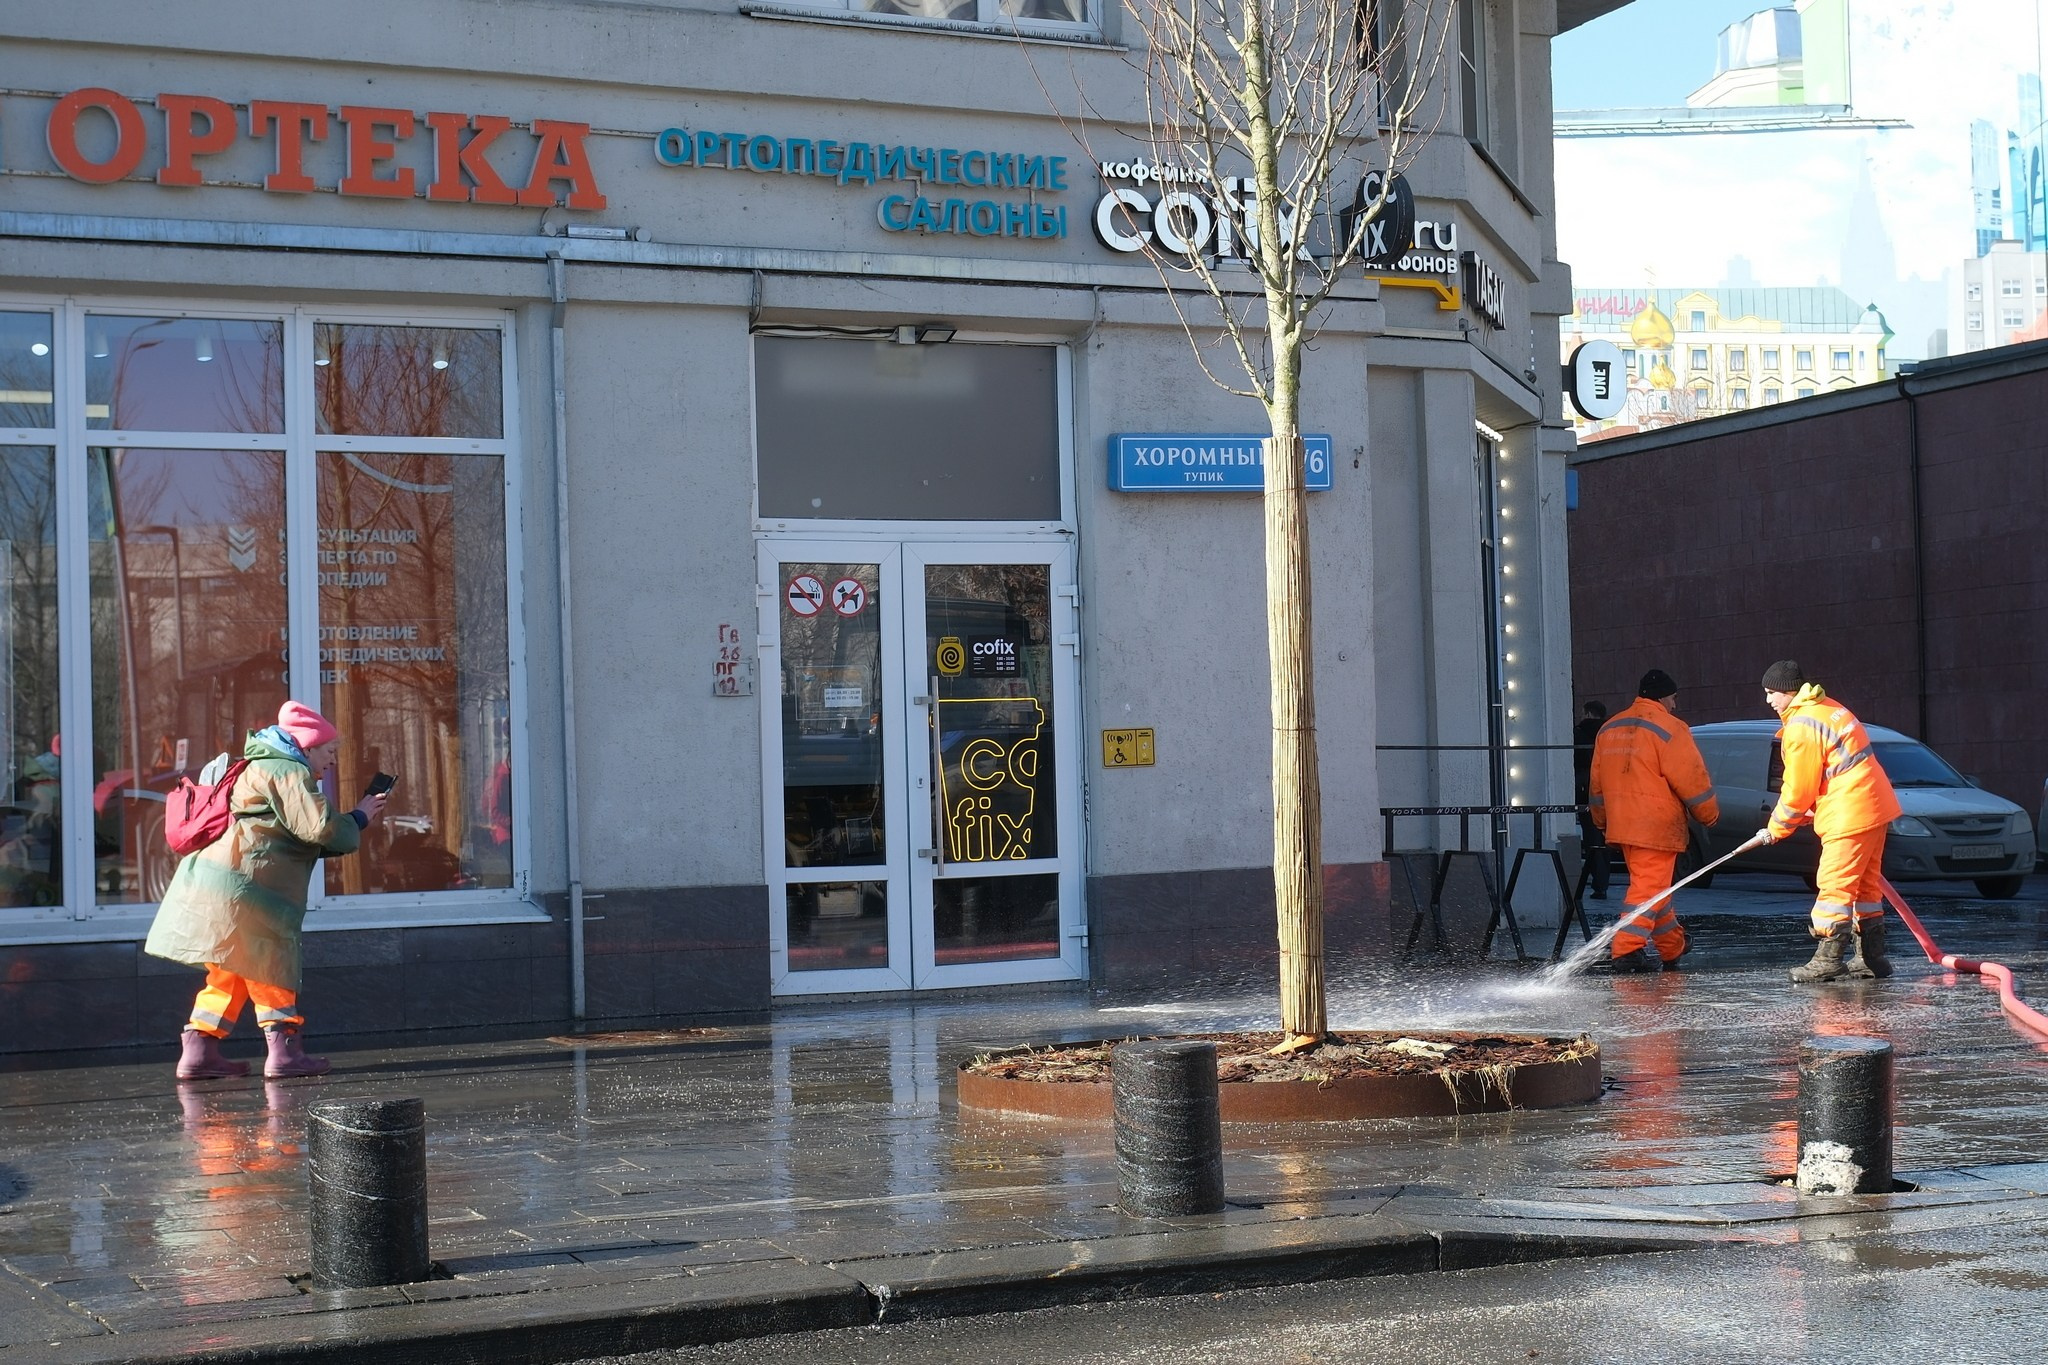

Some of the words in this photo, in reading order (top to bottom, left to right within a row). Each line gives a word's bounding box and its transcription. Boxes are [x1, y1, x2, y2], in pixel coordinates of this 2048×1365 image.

[46, 87, 606, 211] ОРТЕКА
[655, 127, 1068, 192] ОРТОПЕДИЧЕСКИЕ
[877, 194, 1067, 240] САЛОНЫ
[1474, 253, 1506, 330] ТАБАК
[1184, 472, 1224, 482] ТУПИК
[278, 528, 417, 545] КСУЛЬТАЦИЯ
[279, 550, 368, 565] ЭПЕРТА
[373, 551, 397, 565] ПО
[279, 572, 387, 588] ООПЕДИИ
[281, 626, 417, 641] ИОТОВЛЕНИЕ
[973, 638, 1015, 655] cofix
[281, 647, 446, 664] ООПЕДИЧЕСКИХ
[952, 796, 1031, 861] fix
